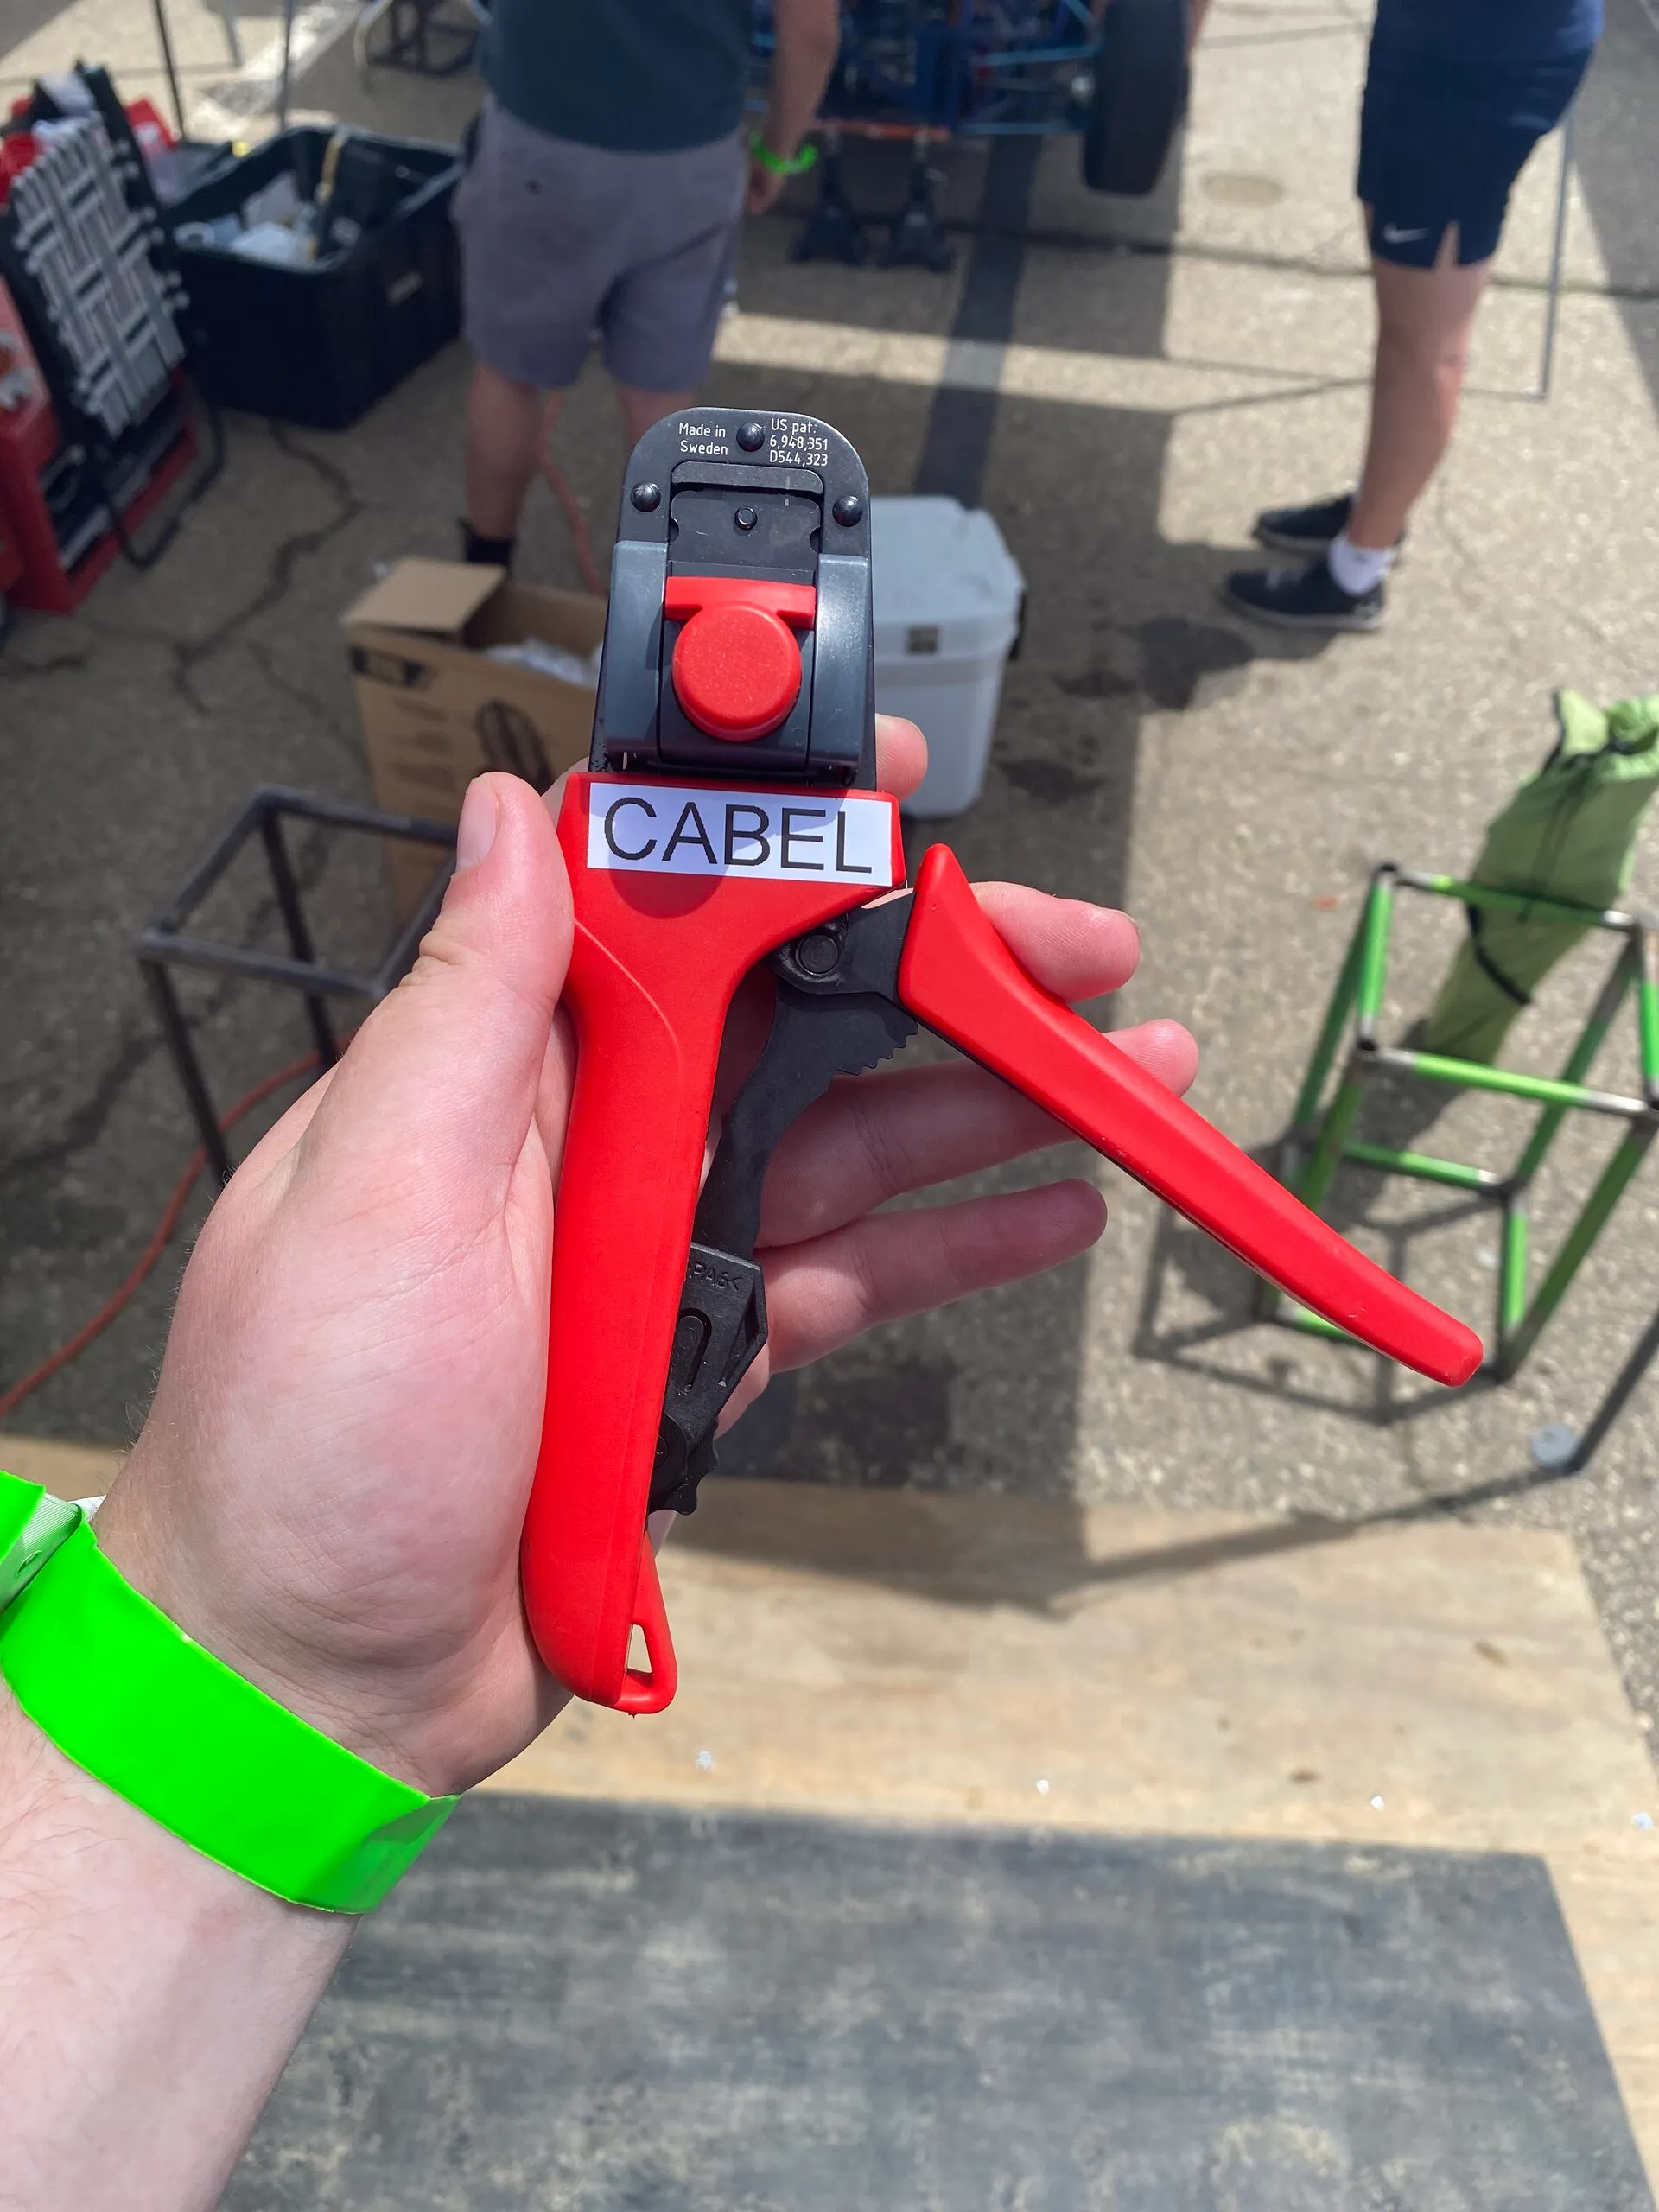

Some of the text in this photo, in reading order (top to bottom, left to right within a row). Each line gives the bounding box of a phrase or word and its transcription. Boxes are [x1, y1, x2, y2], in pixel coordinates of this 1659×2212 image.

[678, 423, 726, 438] Made in
[771, 418, 817, 435] US pat:
[680, 440, 728, 455] Sweden
[769, 435, 828, 451] 6,948,351
[769, 449, 828, 467] D544,323
[604, 797, 873, 874] CABEL
